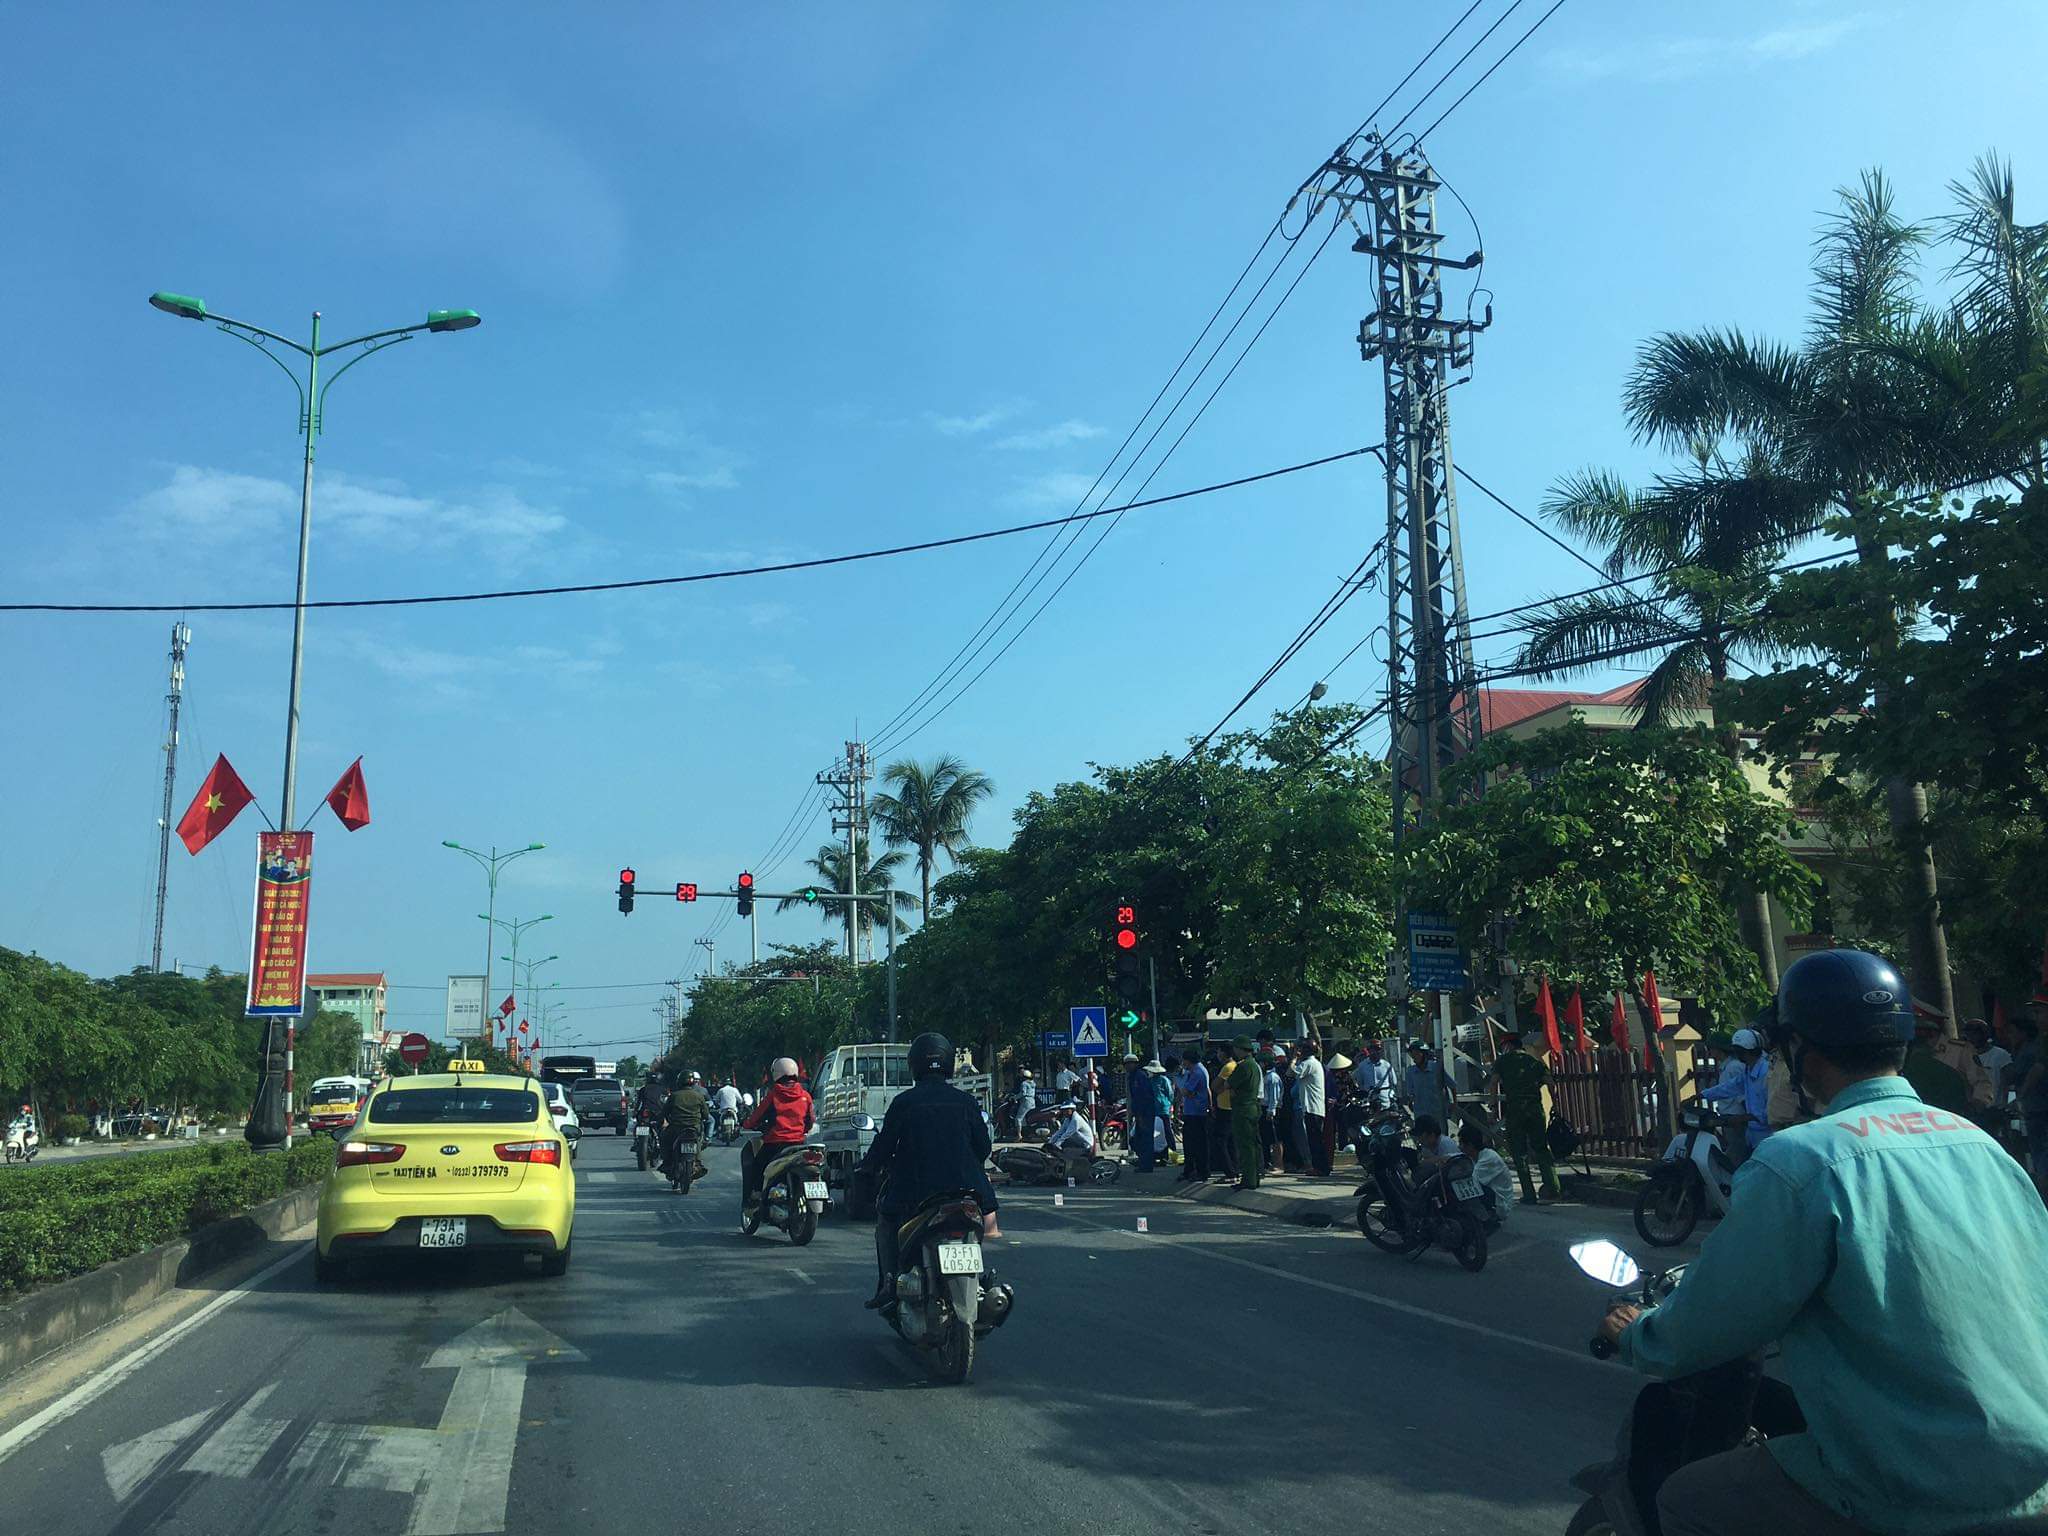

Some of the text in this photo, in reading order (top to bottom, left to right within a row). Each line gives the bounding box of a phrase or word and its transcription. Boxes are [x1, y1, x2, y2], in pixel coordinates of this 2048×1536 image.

[678, 885, 695, 900] 29
[1118, 907, 1134, 923] 29
[454, 1061, 479, 1070] TAXI
[442, 1145, 458, 1154] KIA
[394, 1168, 408, 1177] TAXI
[427, 1167, 437, 1178] SA
[472, 1165, 509, 1177] 3797979
[432, 1219, 455, 1233] 73A
[422, 1233, 465, 1246] 048.46
